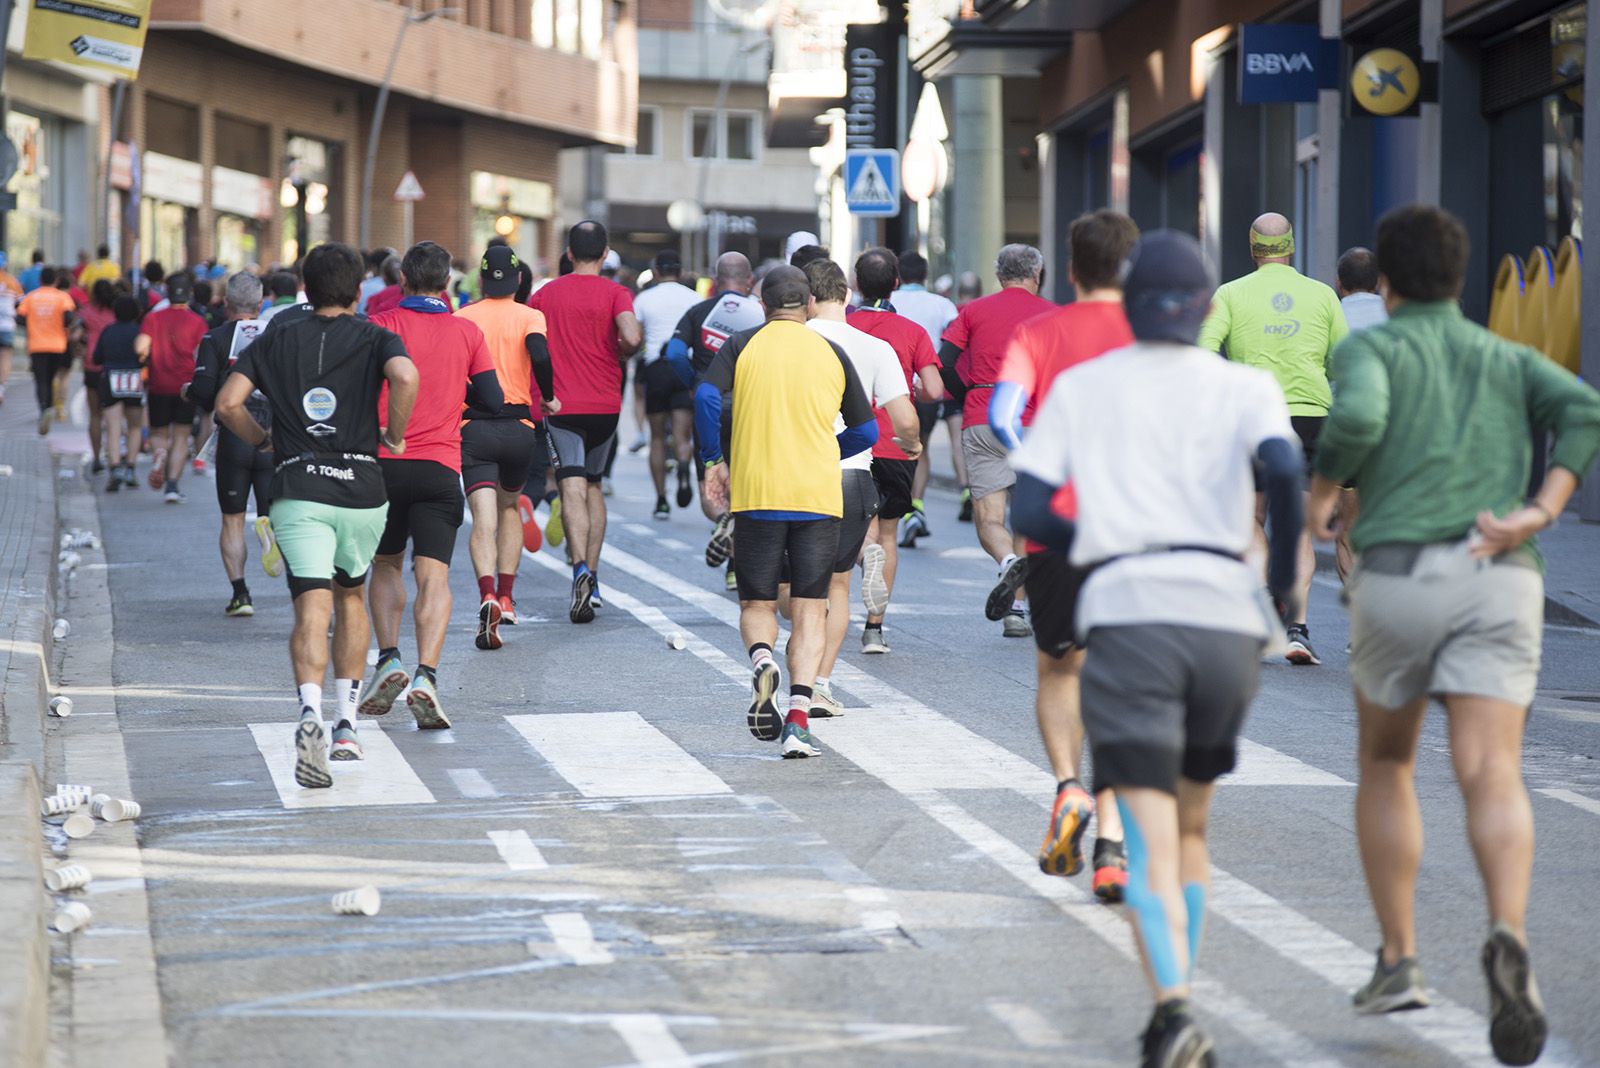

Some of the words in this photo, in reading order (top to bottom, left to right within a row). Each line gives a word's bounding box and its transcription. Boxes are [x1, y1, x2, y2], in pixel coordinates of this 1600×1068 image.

[1246, 52, 1314, 75] BBVA
[306, 464, 317, 475] P.
[318, 465, 355, 480] TORNÉ
